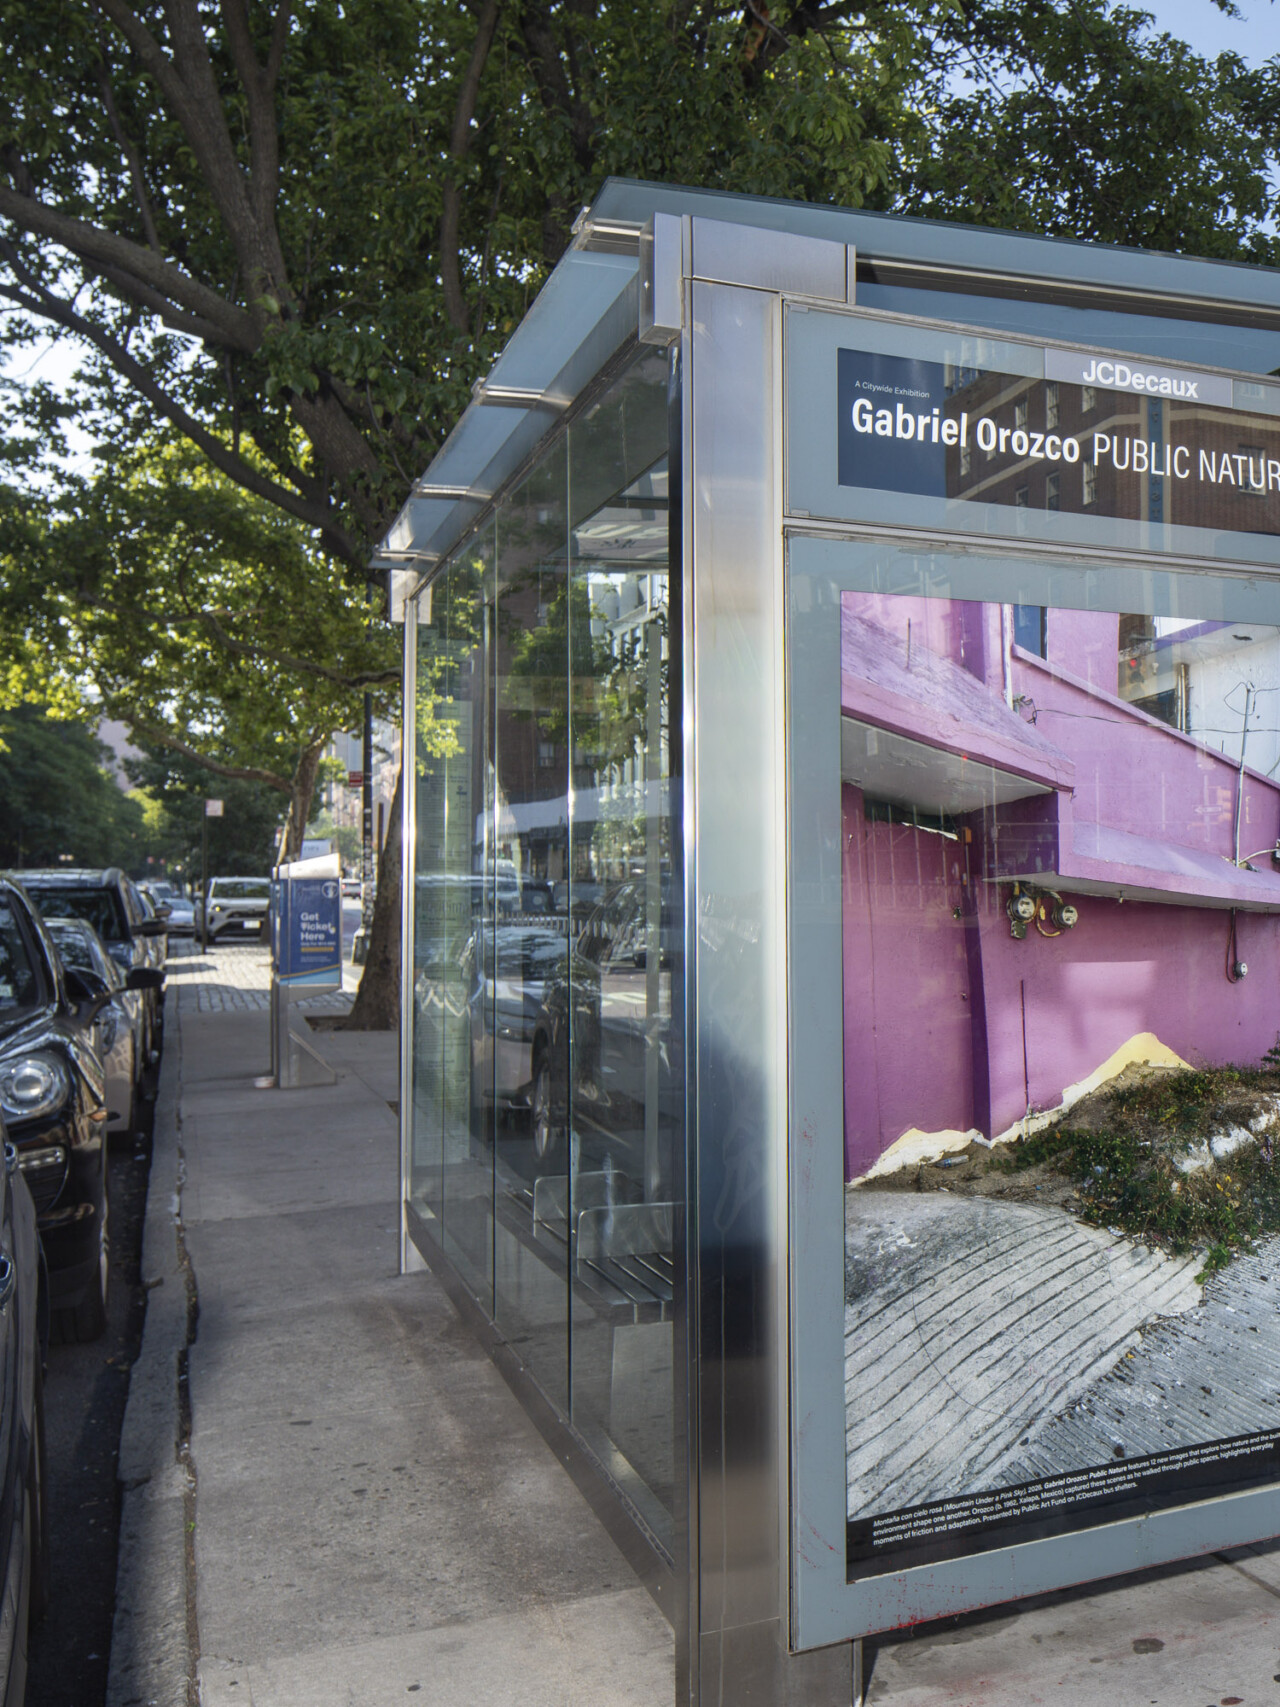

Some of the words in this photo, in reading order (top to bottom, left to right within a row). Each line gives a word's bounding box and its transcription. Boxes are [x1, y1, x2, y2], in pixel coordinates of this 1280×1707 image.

[855, 380, 861, 388] A
[862, 381, 893, 394] Citywide
[895, 386, 930, 398] Exhibition
[1082, 360, 1199, 398] JCDecaux
[852, 398, 968, 447] Gabriel
[976, 417, 1080, 463] Orozco
[1093, 432, 1190, 479] PUBLIC
[301, 912, 319, 921] Get
[301, 932, 325, 941] Here
[873, 1522, 912, 1537] environment
[912, 1517, 932, 1528] shape
[933, 1514, 946, 1522] one
[946, 1510, 971, 1520] another.
[971, 1506, 994, 1515] Orozco
[1040, 1489, 1065, 1499] Mexico)
[1065, 1482, 1090, 1494] captured
[1090, 1479, 1106, 1488] these
[1106, 1475, 1127, 1484] scenes
[1142, 1466, 1162, 1476] walked
[1162, 1462, 1183, 1472] through
[1183, 1458, 1200, 1468] public
[1220, 1447, 1251, 1459] highlighting
[1251, 1442, 1275, 1452] everyday
[901, 1513, 913, 1521] con
[913, 1509, 928, 1518] cielo
[929, 1506, 943, 1515] rosa
[943, 1499, 975, 1513] (Mountain
[975, 1496, 994, 1505] Under
[1000, 1491, 1013, 1500] Pink
[1044, 1478, 1066, 1489] Gabriel
[1066, 1474, 1089, 1484] Orozco:
[1089, 1470, 1107, 1479] Public
[1108, 1466, 1128, 1475] Nature
[1128, 1461, 1150, 1470] features
[1169, 1452, 1189, 1461] images
[1189, 1449, 1200, 1457] that
[1200, 1445, 1220, 1455] explore
[873, 1534, 903, 1546] moments
[904, 1531, 911, 1539] of
[911, 1527, 934, 1537] friction
[934, 1524, 947, 1532] and
[948, 1518, 982, 1531] adaptation.
[982, 1510, 1013, 1522] Presented
[1012, 1508, 1021, 1516] by
[1021, 1503, 1040, 1513] Public
[1040, 1500, 1051, 1509] Art
[1051, 1497, 1067, 1506] Fund
[1076, 1490, 1103, 1501] JCDecaux
[1114, 1482, 1139, 1492] shelters.
